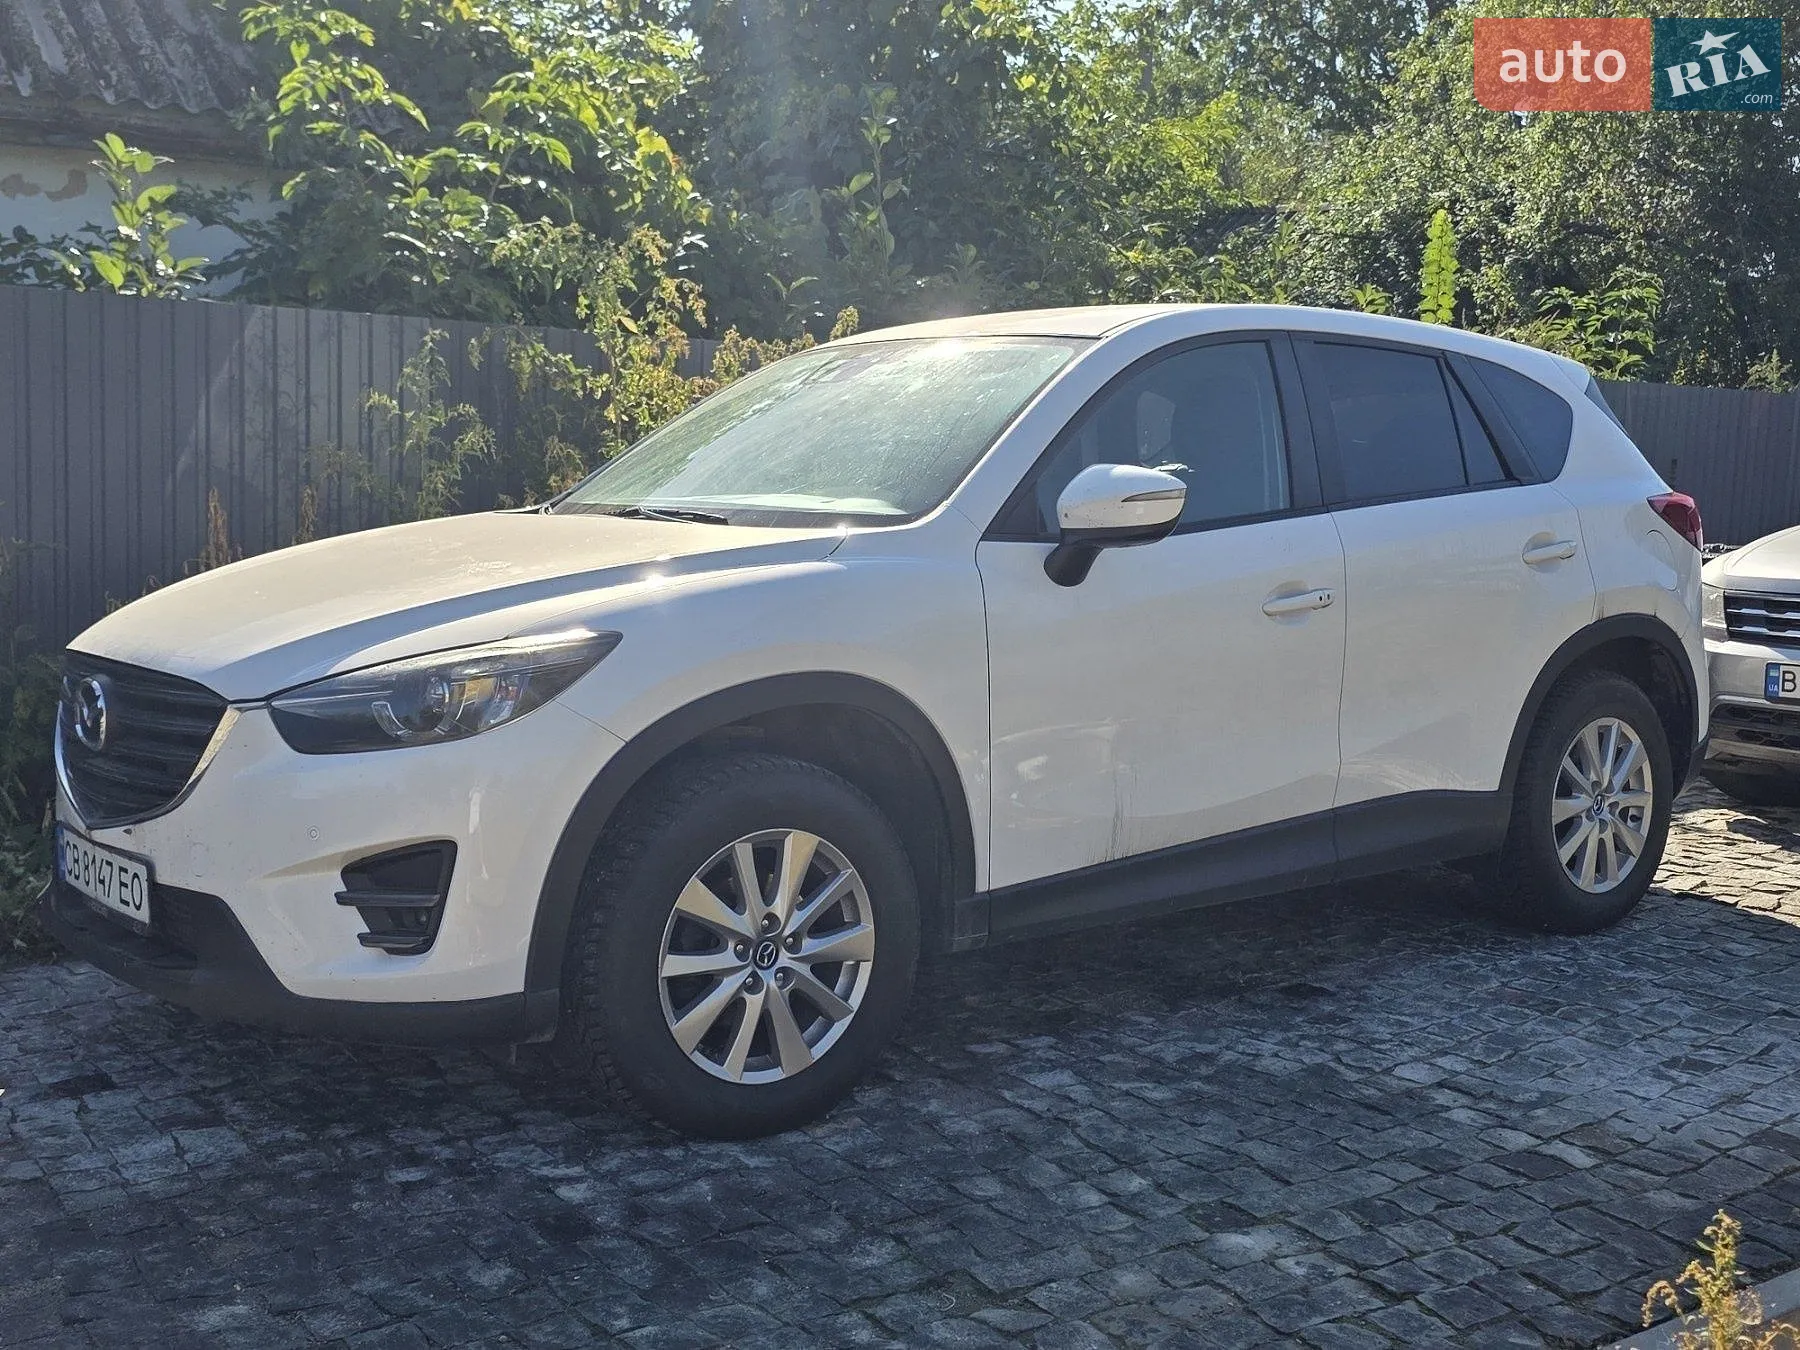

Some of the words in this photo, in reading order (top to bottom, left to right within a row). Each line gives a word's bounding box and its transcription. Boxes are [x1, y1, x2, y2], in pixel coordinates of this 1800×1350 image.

[1768, 684, 1779, 692] UA
[65, 840, 80, 881] CB
[83, 850, 113, 898] 8147
[118, 865, 143, 911] EO
